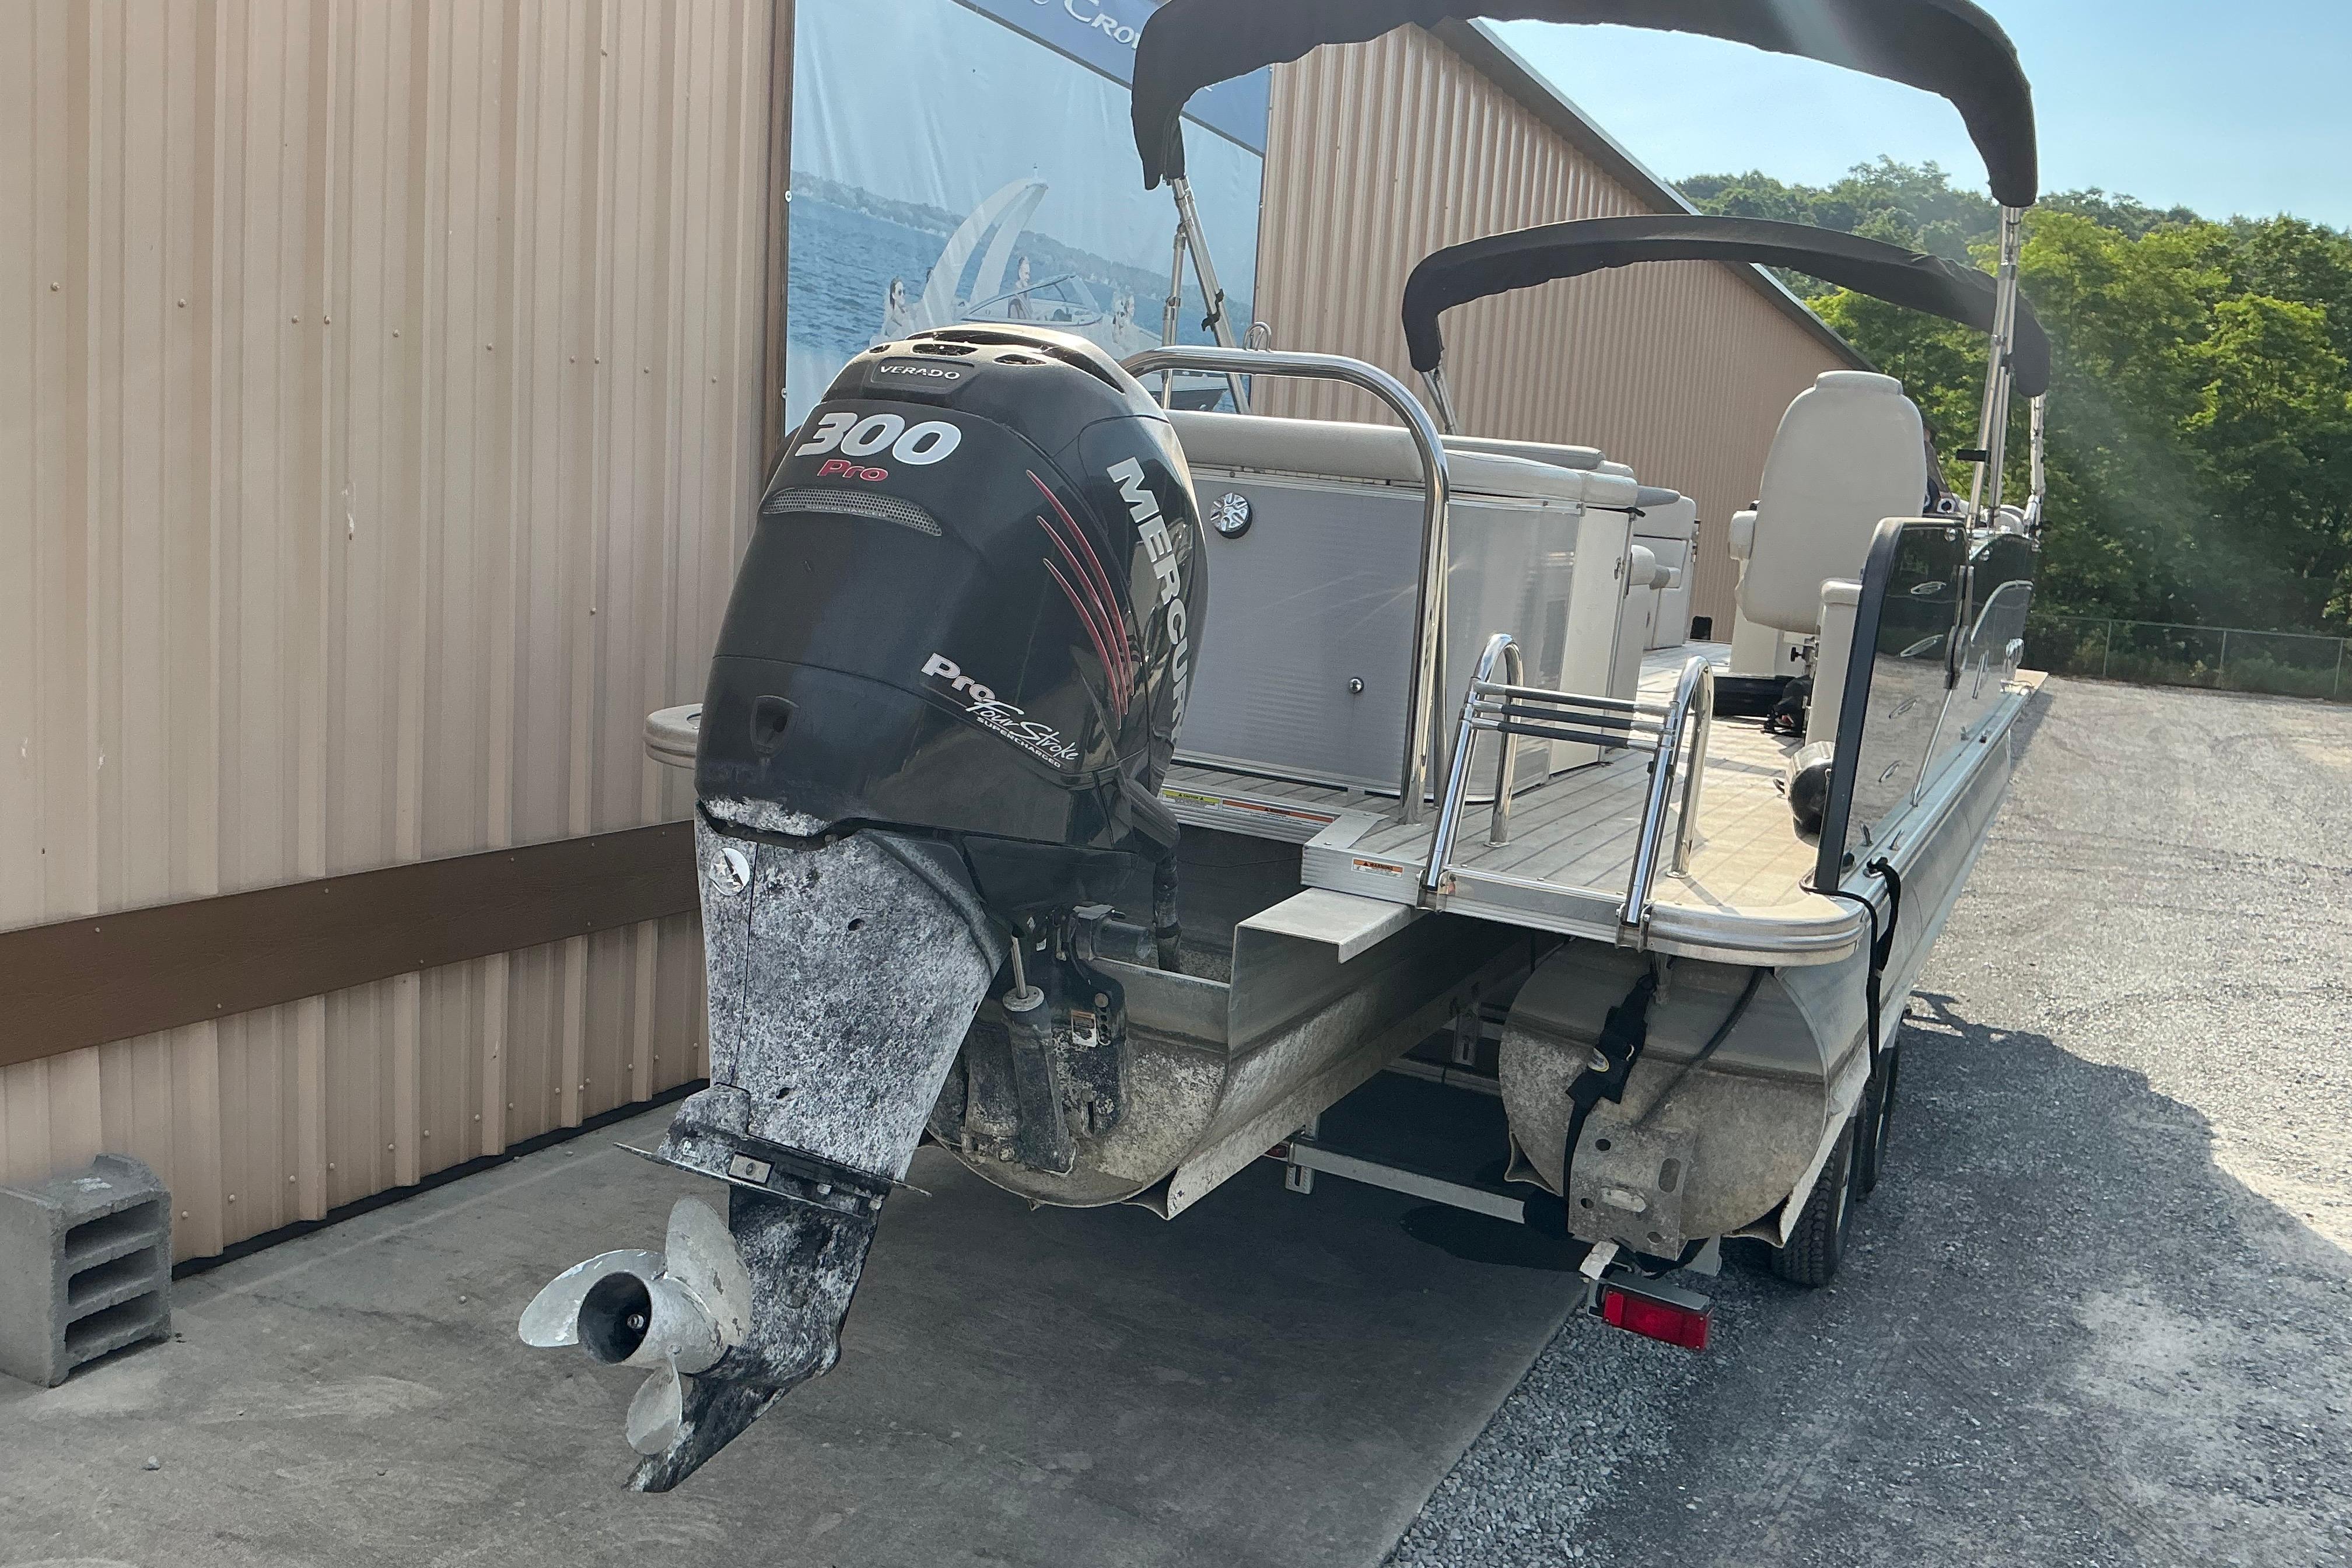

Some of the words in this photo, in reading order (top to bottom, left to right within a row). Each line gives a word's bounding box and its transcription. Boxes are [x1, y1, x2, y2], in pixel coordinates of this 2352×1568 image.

[880, 365, 961, 380] VERADO
[794, 412, 962, 466] 300
[817, 459, 888, 482] Pro
[921, 652, 996, 702] Pro
[976, 716, 1062, 769] SUPERCHARGED
